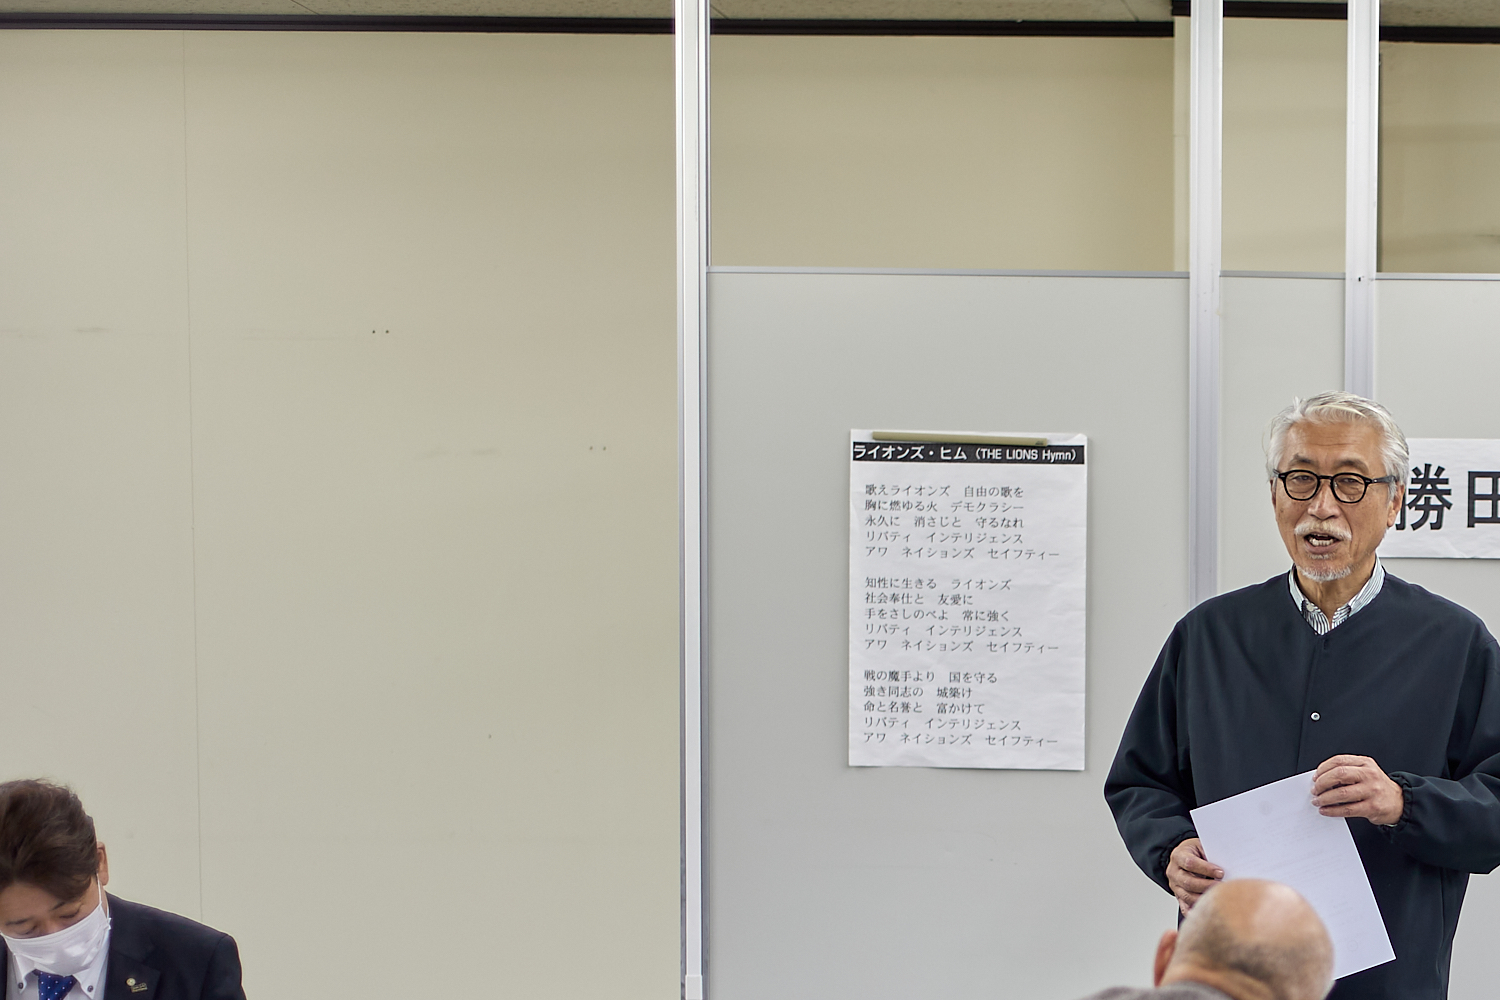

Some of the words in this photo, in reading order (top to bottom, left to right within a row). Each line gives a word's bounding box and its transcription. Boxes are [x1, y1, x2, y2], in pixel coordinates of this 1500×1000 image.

[1006, 448, 1038, 461] LIONS
[864, 483, 951, 497] 歌えライオンズ
[964, 485, 1024, 499] 自由の歌を
[863, 498, 939, 513] 胸に燃ゆる火
[950, 500, 1025, 514] デモクラシー
[864, 514, 901, 528] 永久に
[913, 515, 962, 529] 消さじと
[975, 516, 1025, 529] 守るなれ
[866, 530, 911, 543] リバティ
[926, 532, 1024, 545] インテリジェンス
[865, 545, 888, 557] アワ
[901, 546, 976, 559] ネイションズ
[987, 547, 1060, 561] セイフティー
[864, 576, 937, 590] 知性に生きる
[951, 578, 1012, 591] ライオンズ
[864, 591, 924, 605] 社会奉仕と
[937, 592, 974, 607] 友愛に
[864, 607, 949, 621] 手をさしのべよ
[961, 609, 1009, 623] 常に強く
[865, 623, 910, 636] リバティ
[925, 624, 1023, 638] インテリジェンス
[864, 638, 888, 650] アワ
[901, 639, 974, 652] ネイションズ
[986, 641, 1059, 654] セイフティー
[863, 669, 935, 683] 戦の魔手より
[948, 671, 998, 684] 国を守る
[863, 684, 924, 699] 強き同志の
[936, 686, 973, 700] 城築け
[863, 699, 923, 714] 命と名誉と
[936, 701, 985, 715] 富かけて
[864, 715, 909, 729] リバティ
[924, 717, 1022, 731] インテリジェンス
[863, 731, 887, 744] アワ
[899, 732, 973, 746] ネイションズ
[984, 734, 1058, 747] セイフティー
